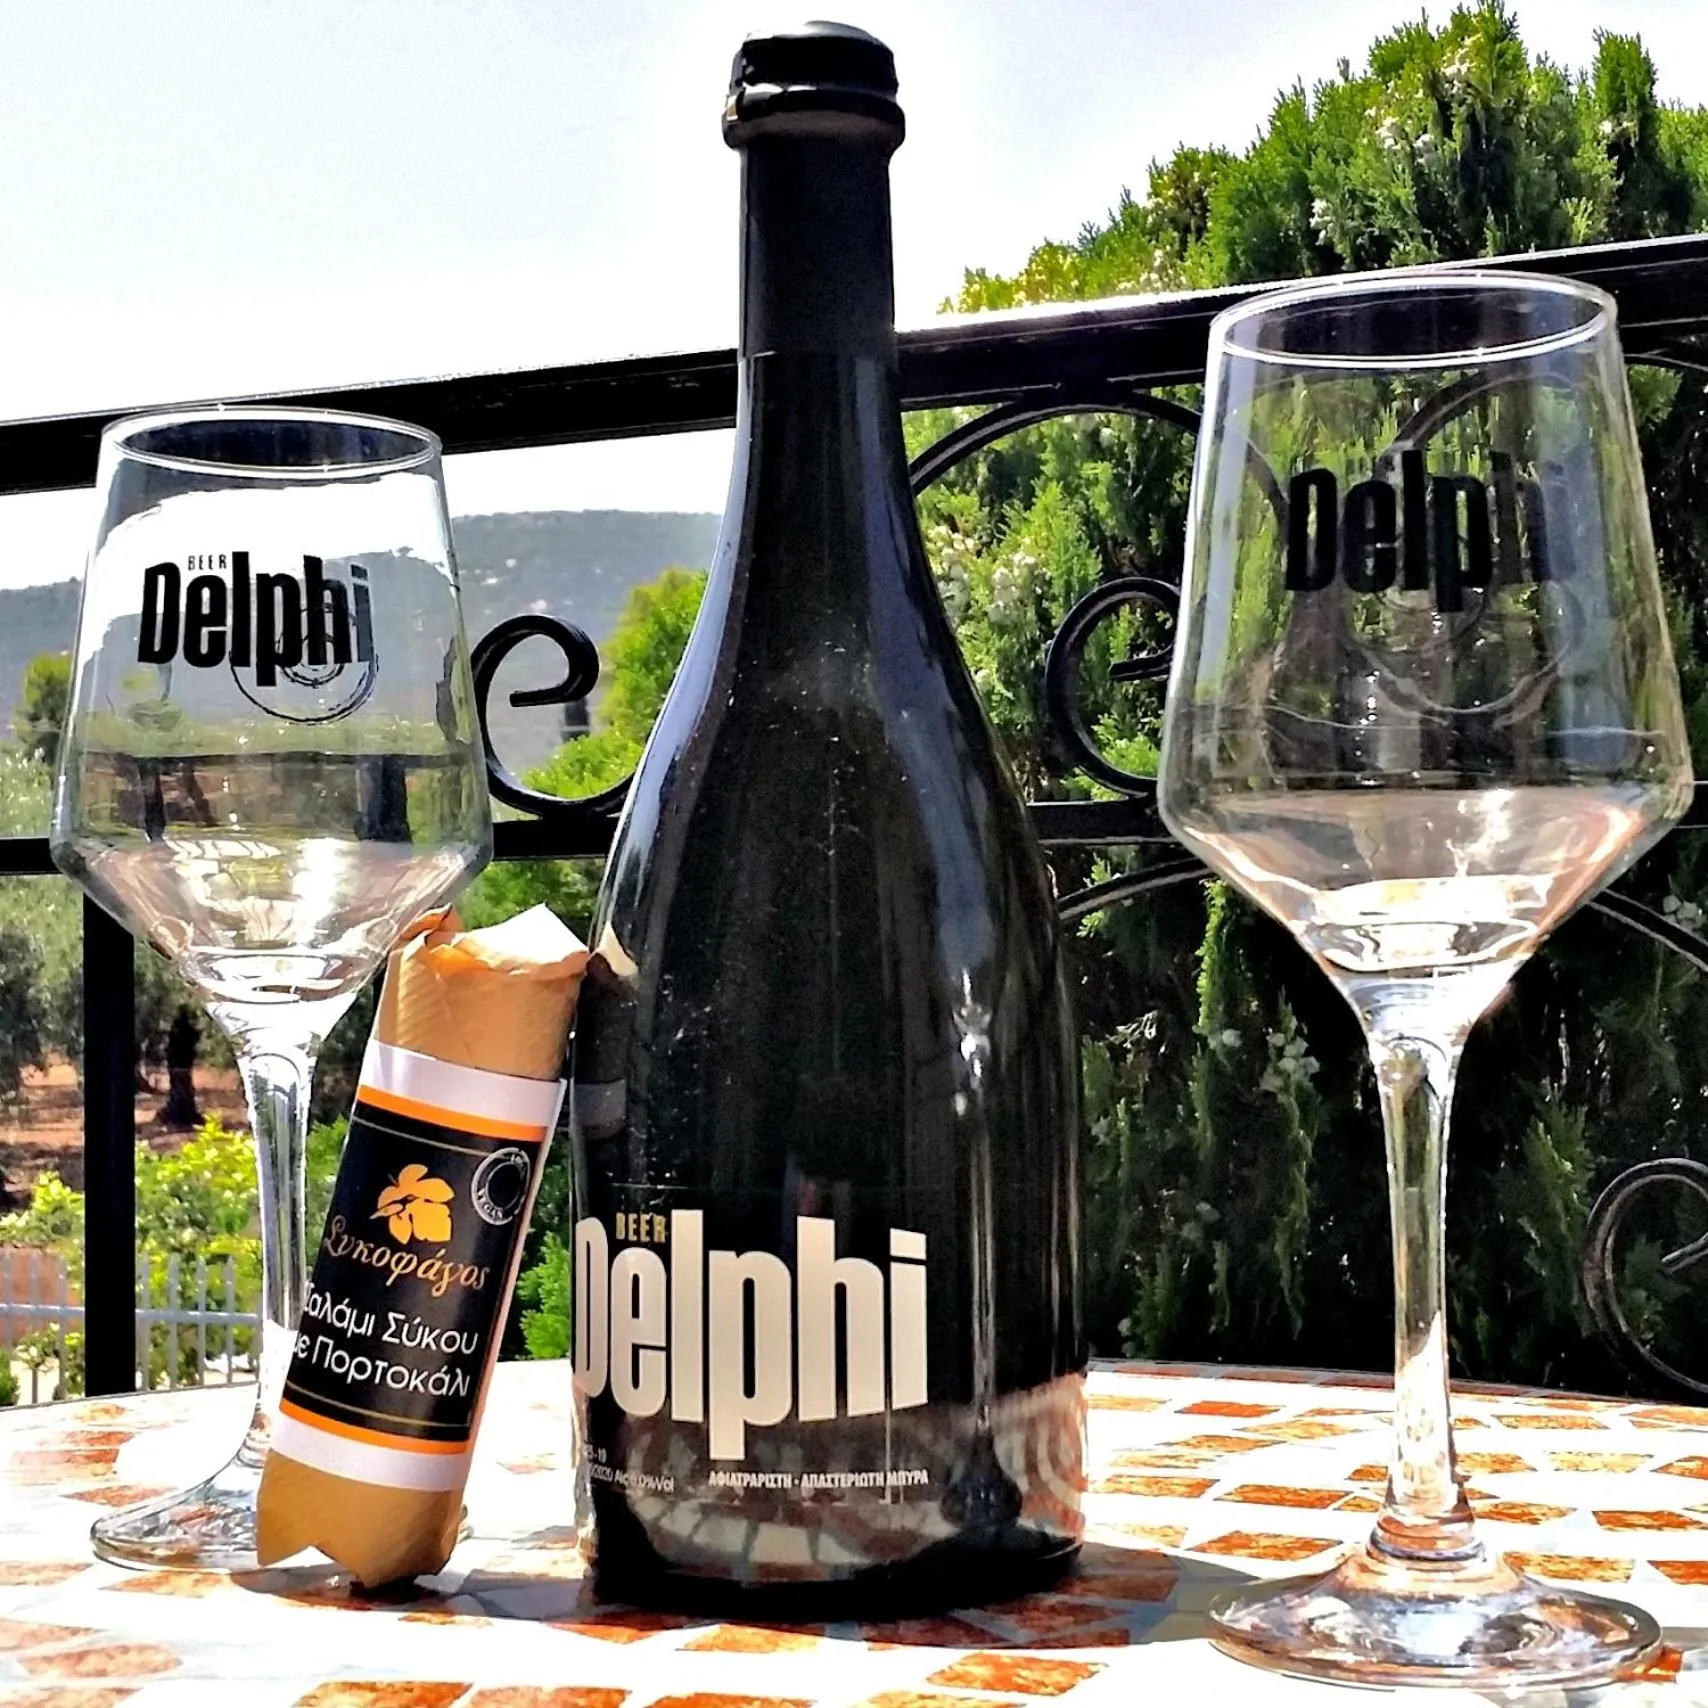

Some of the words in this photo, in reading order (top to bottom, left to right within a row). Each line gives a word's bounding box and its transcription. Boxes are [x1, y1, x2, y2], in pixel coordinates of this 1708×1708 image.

[187, 554, 227, 571] BEER
[137, 551, 374, 687] Delphi
[323, 1215, 490, 1297] Συκοφάγος
[615, 1212, 667, 1243] BEER
[382, 1311, 478, 1355] Σύκου
[575, 1209, 928, 1461] Delphi
